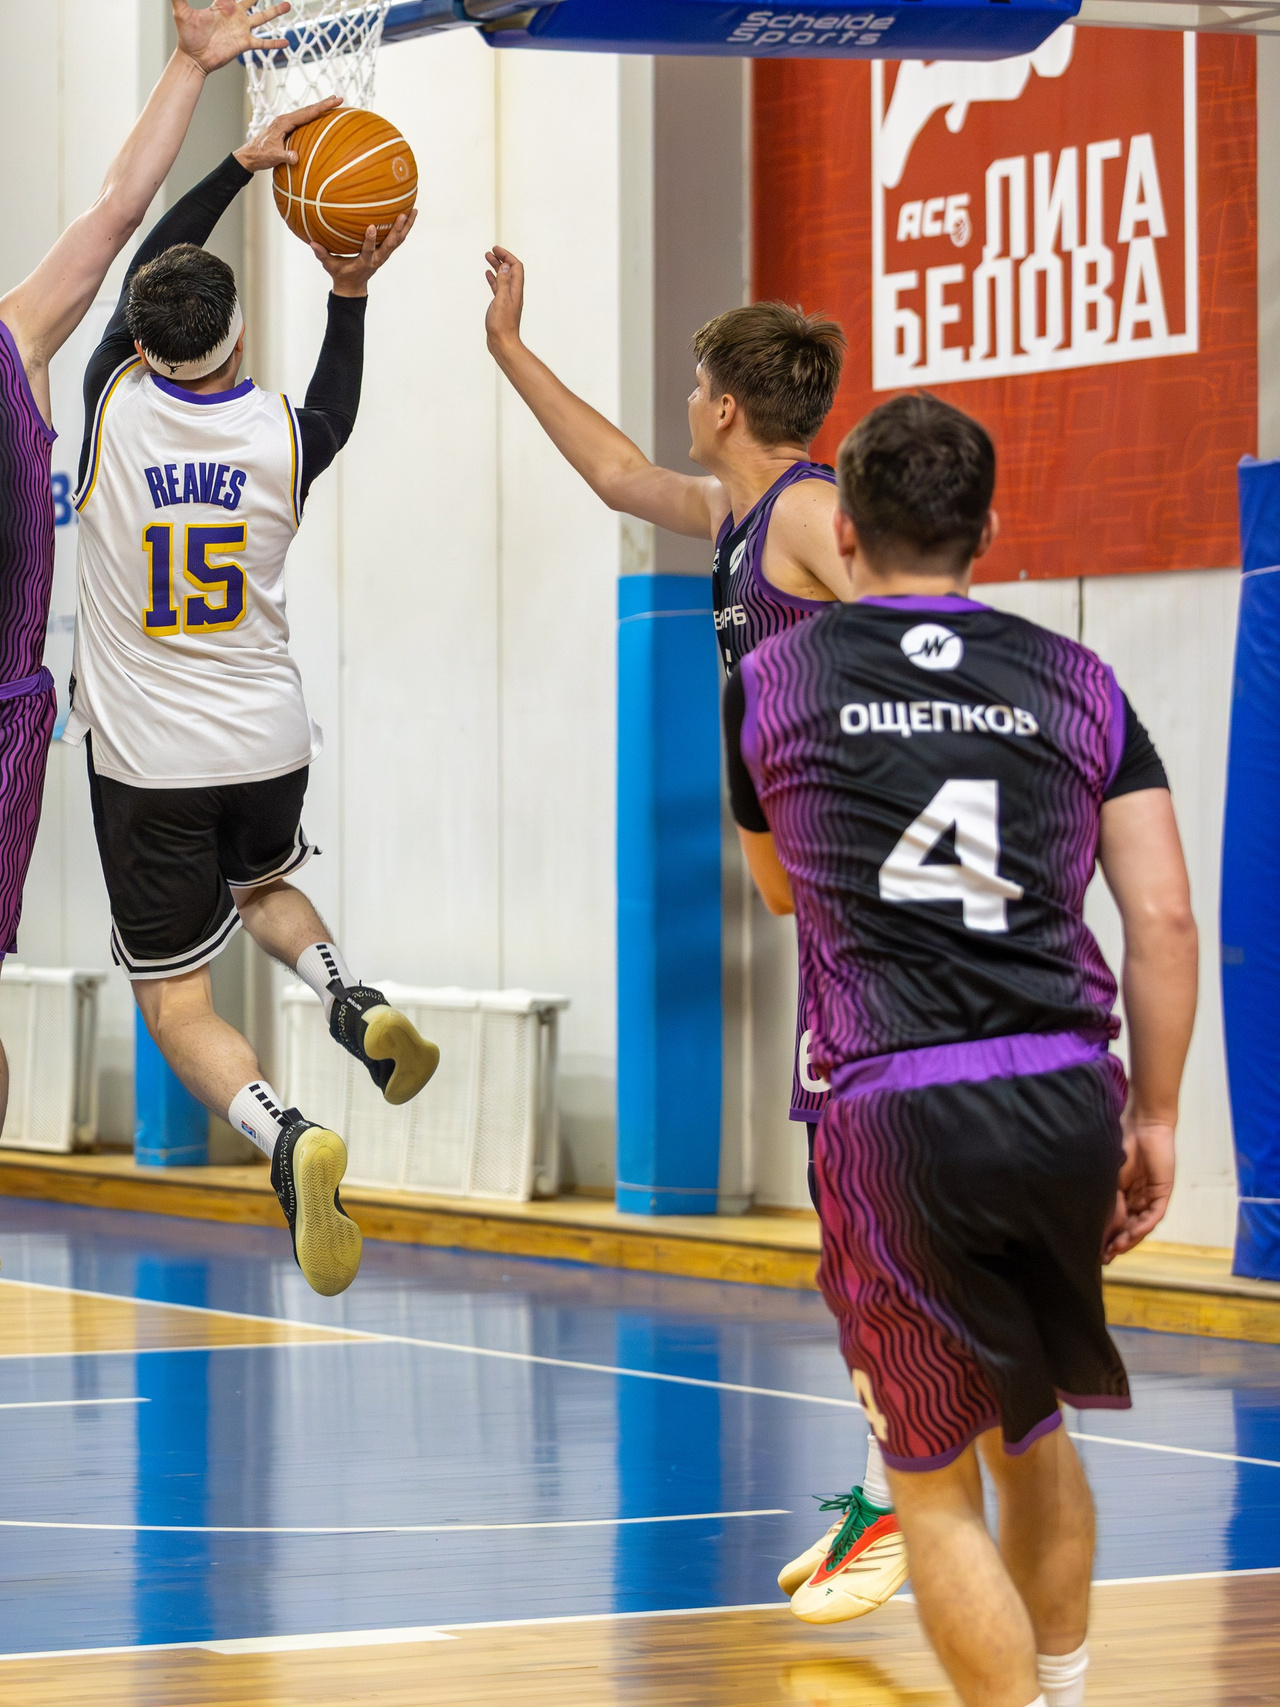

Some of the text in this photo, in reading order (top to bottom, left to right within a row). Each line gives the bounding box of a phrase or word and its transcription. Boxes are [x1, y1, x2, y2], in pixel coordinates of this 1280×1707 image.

[726, 27, 883, 47] Sports
[982, 133, 1168, 264] ЛИГА
[876, 236, 1169, 374] БЕЛОВА
[144, 462, 247, 511] REAVES
[142, 522, 248, 637] 15
[839, 700, 1041, 739] ОЩЕПКОВ
[878, 779, 1025, 933] 4
